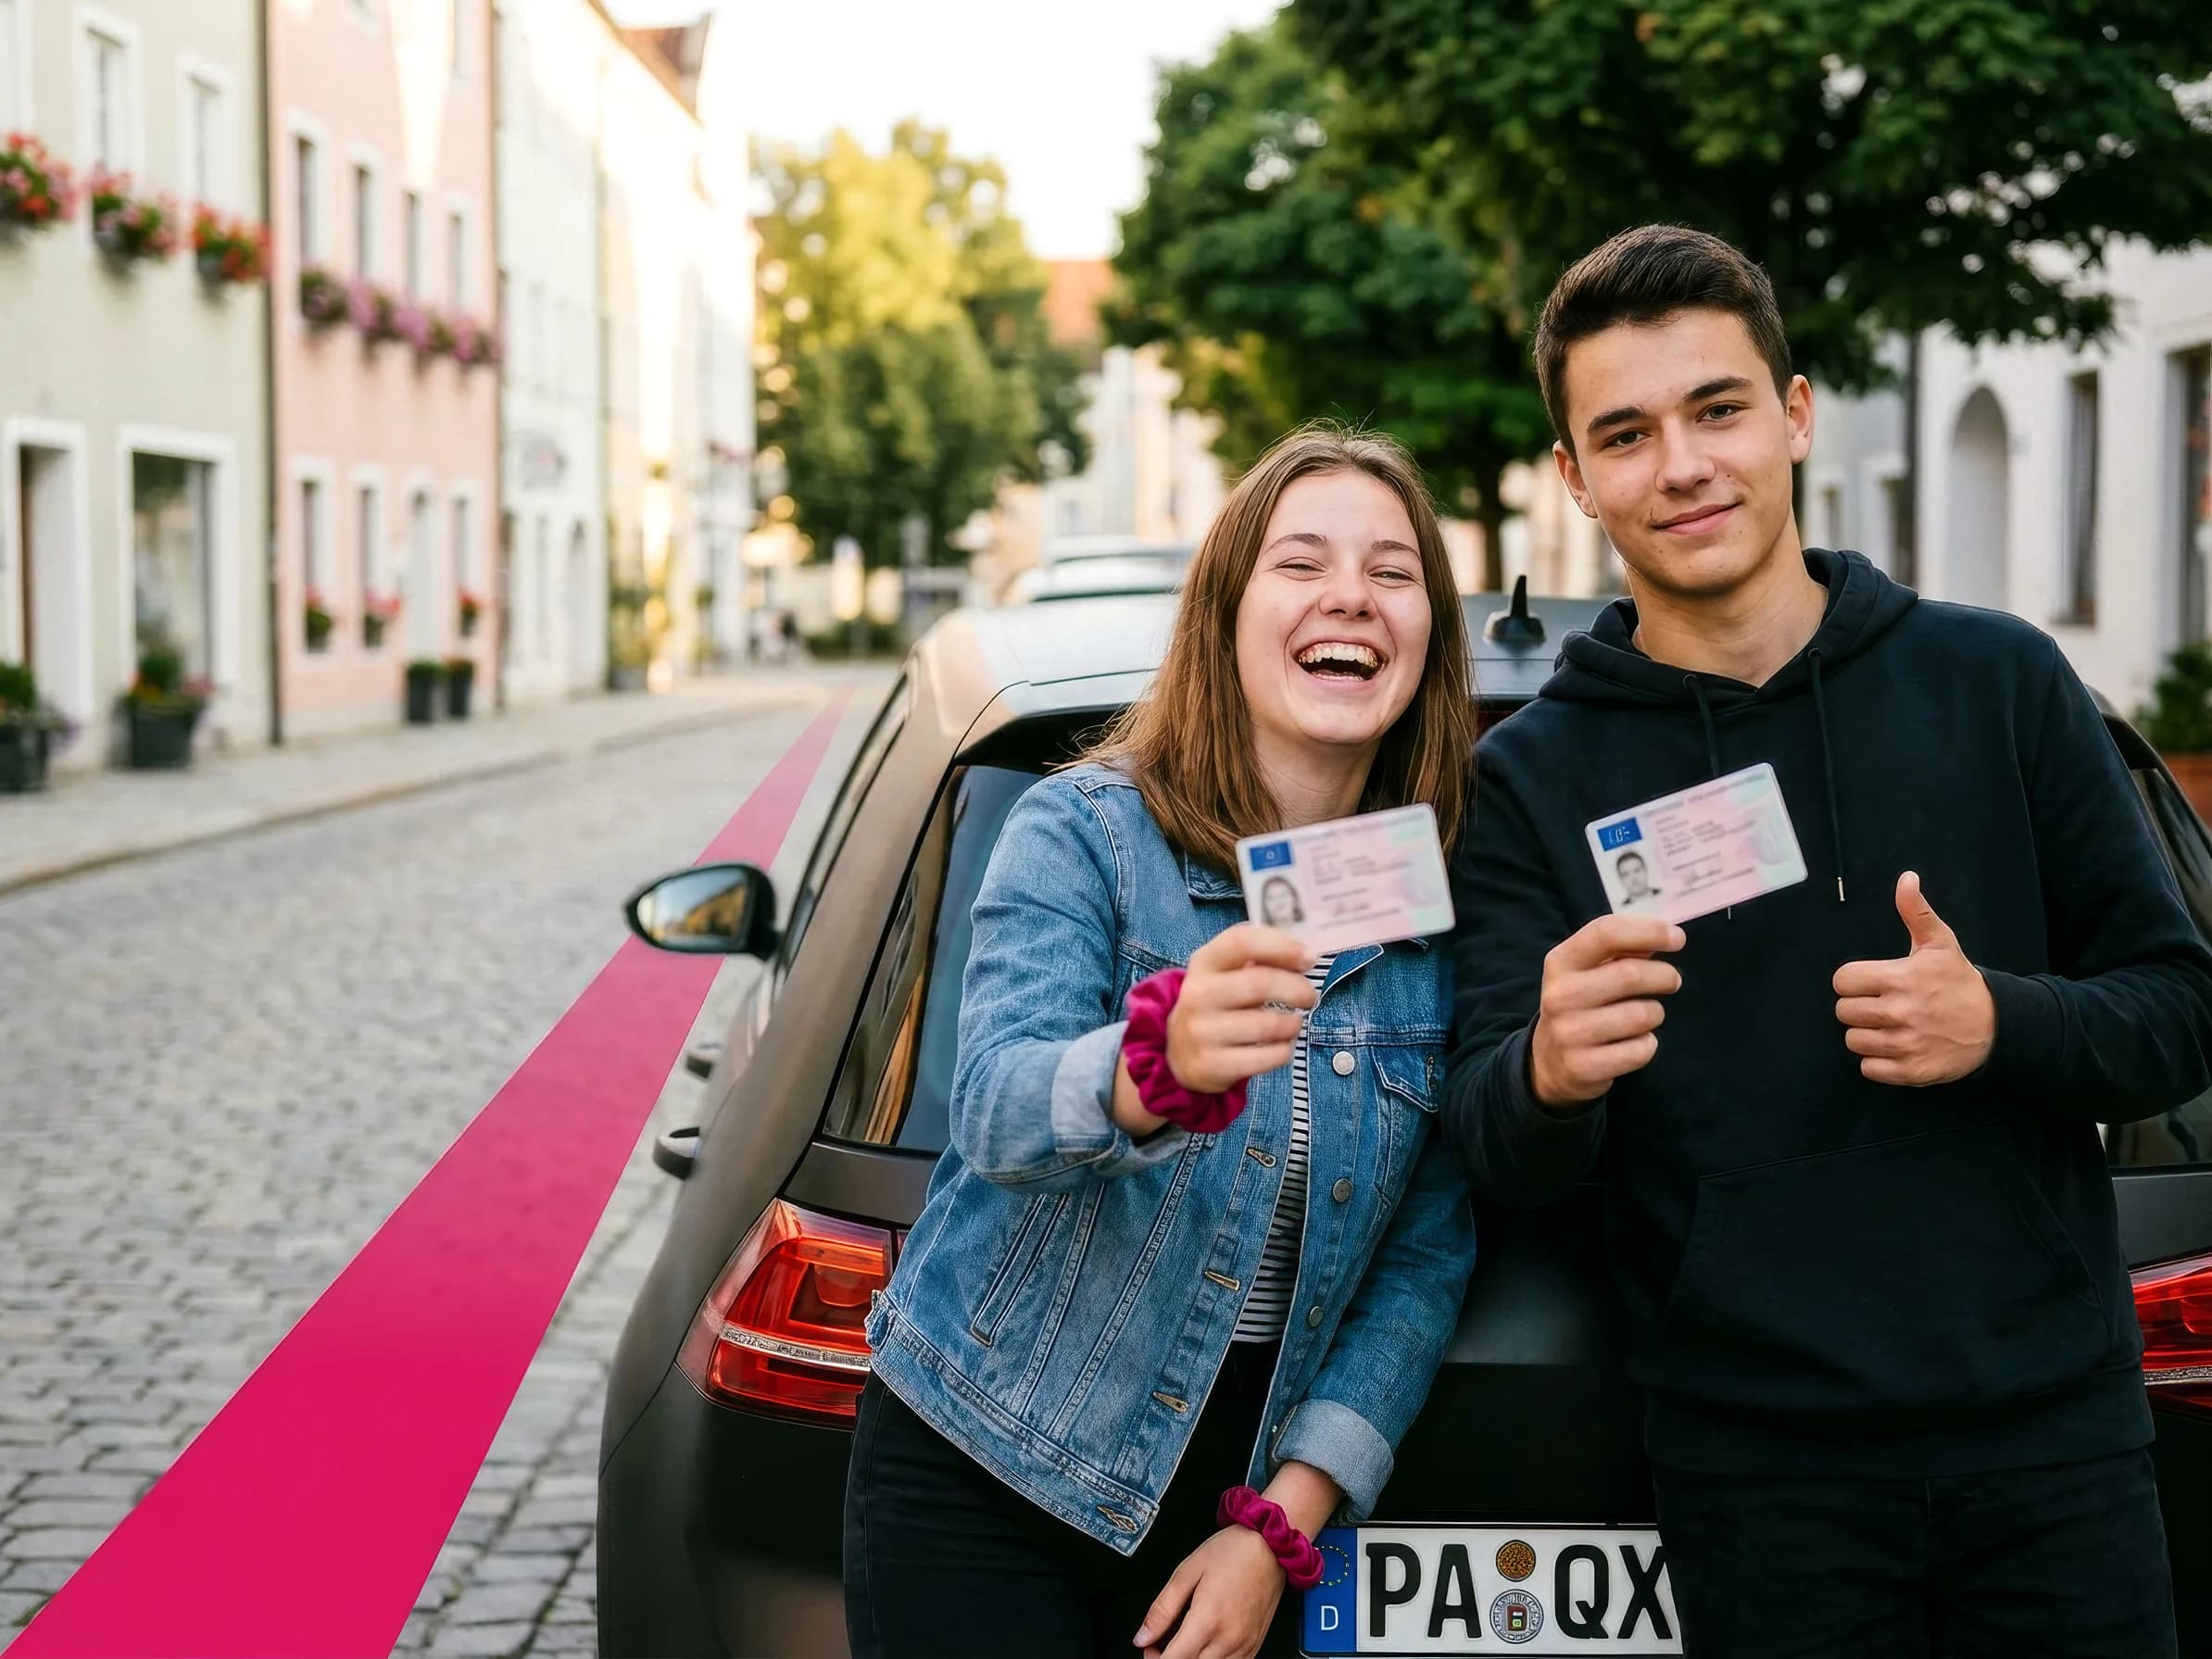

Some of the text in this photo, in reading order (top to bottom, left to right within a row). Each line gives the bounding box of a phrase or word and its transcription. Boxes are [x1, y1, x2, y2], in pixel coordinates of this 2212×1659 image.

[1320, 1604, 1339, 1631] D
[1365, 1542, 1482, 1638] PA
[1554, 1544, 1673, 1640] QX
